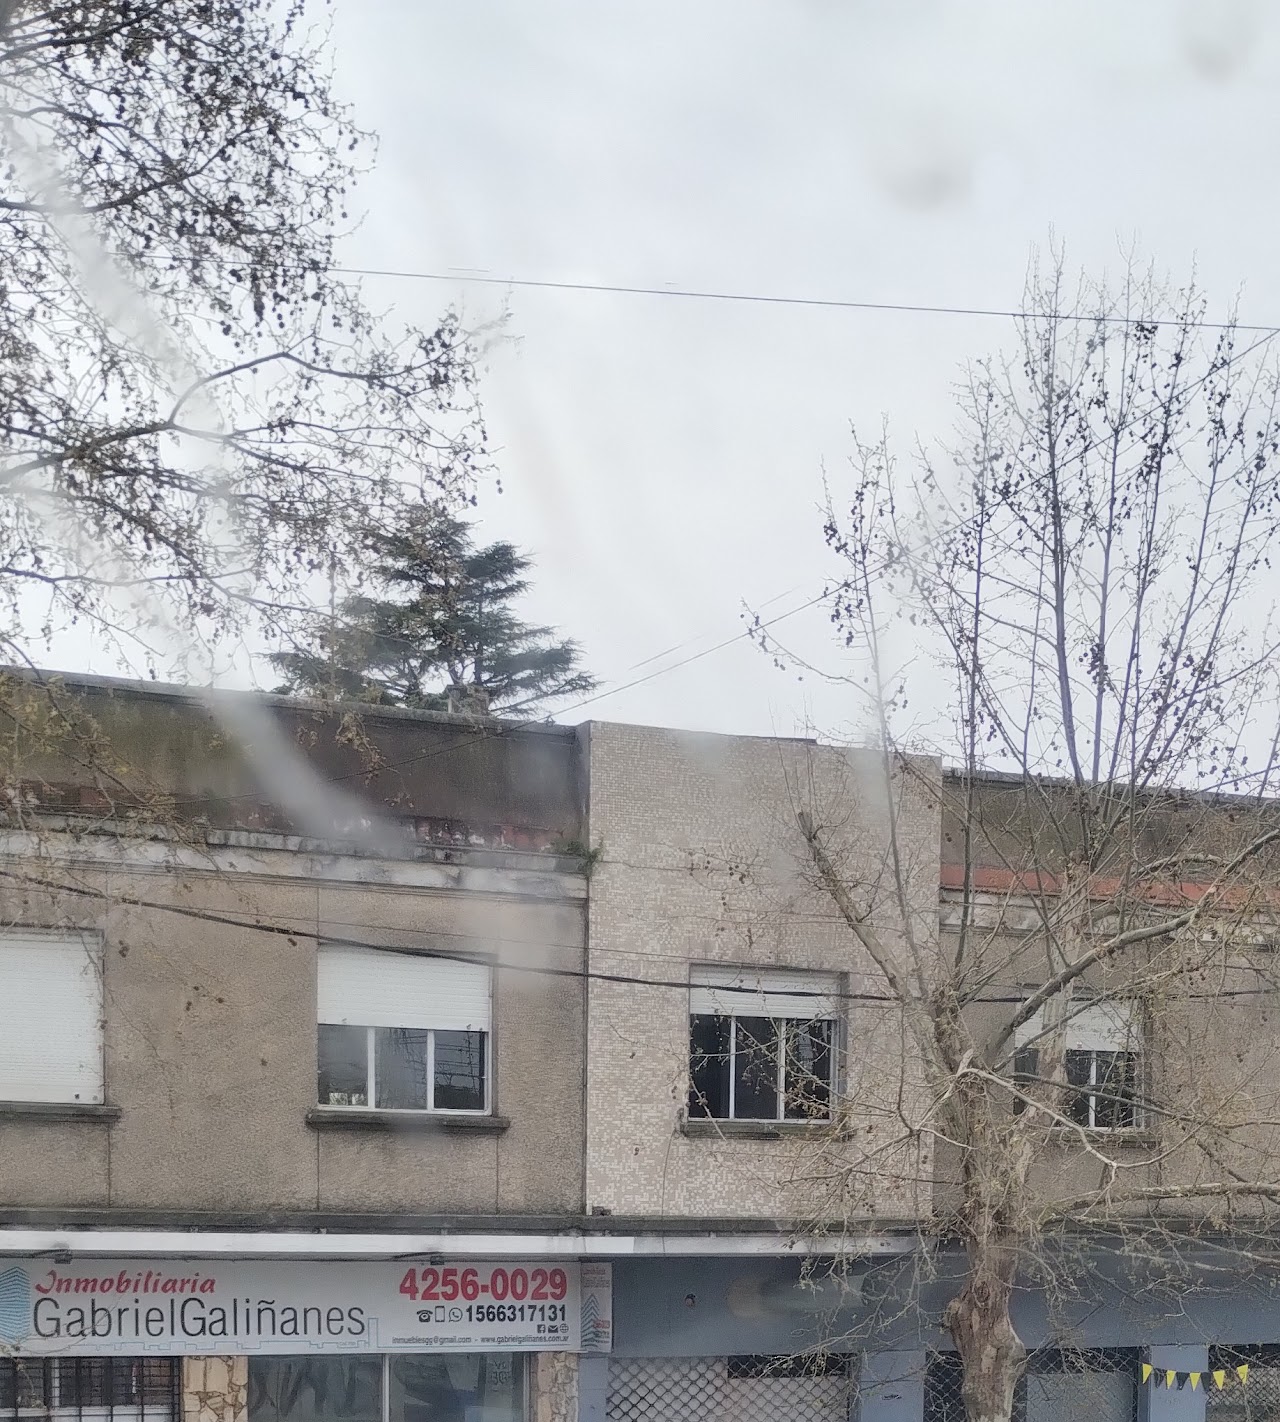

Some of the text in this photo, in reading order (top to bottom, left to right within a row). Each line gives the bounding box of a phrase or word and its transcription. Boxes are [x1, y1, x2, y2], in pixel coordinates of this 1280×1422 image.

[34, 1269, 216, 1294] Inmobiliaria
[399, 1268, 568, 1301] 4256-0029
[33, 1297, 366, 1337] GabrielGaliñanes
[465, 1304, 567, 1323] 1566317131
